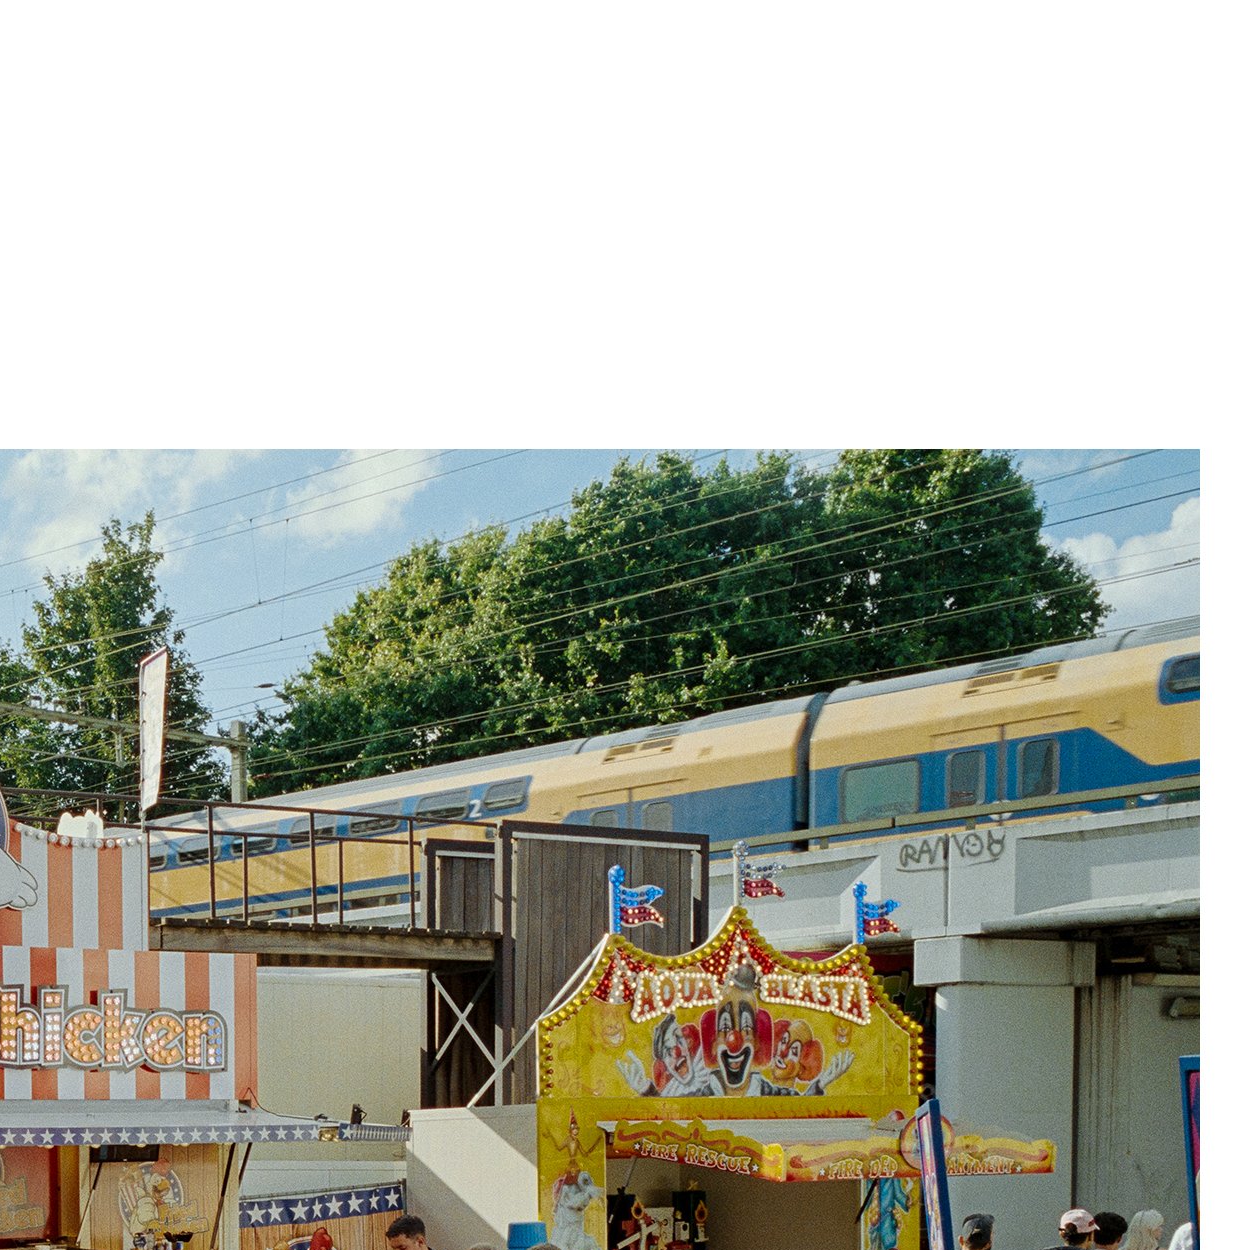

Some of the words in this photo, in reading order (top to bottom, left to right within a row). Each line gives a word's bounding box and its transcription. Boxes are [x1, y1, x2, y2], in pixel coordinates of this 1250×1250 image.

[469, 799, 482, 818] 2
[764, 974, 867, 1021] BLASTA
[641, 1138, 679, 1162] FIRE
[685, 1143, 751, 1175] RESCUE
[828, 1158, 863, 1179] FIRE
